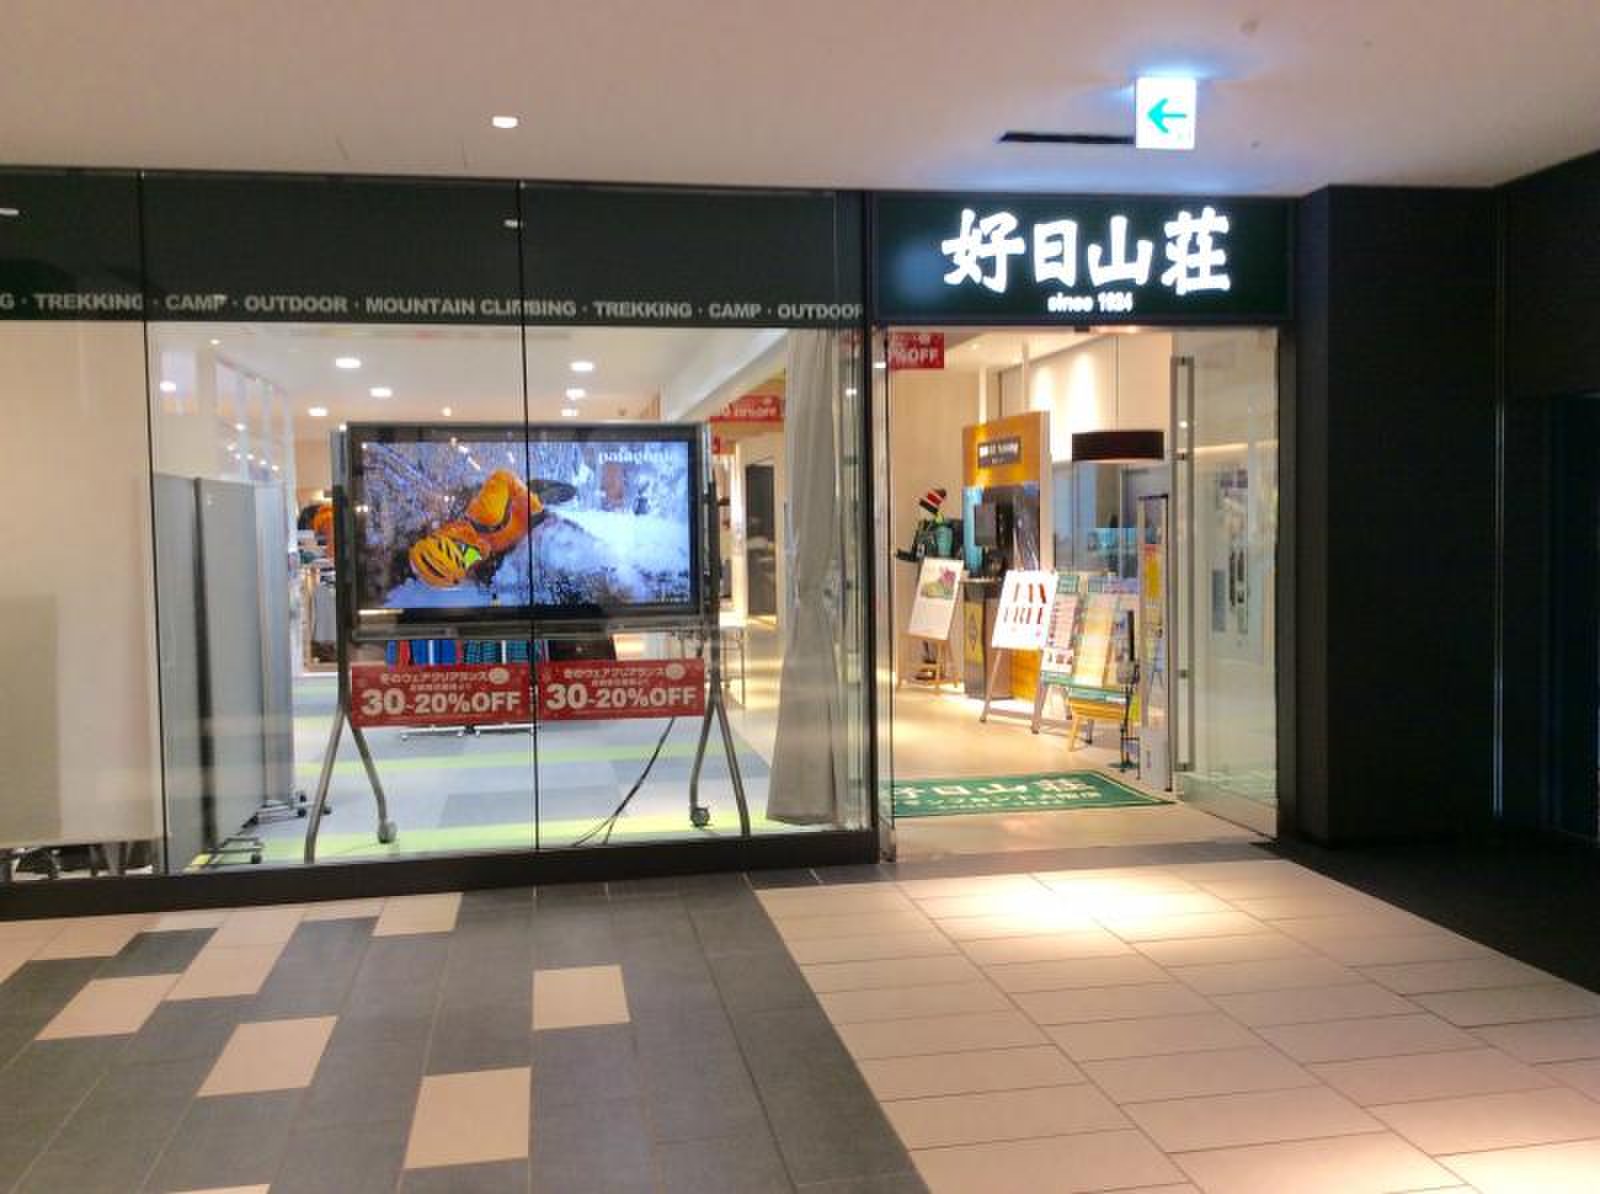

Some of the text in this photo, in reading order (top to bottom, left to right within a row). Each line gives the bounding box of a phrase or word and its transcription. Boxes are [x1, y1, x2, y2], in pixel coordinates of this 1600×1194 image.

[941, 206, 1231, 295] 好日山荘
[34, 293, 143, 311] TREKKING
[165, 294, 227, 311] CAMP
[244, 295, 348, 313] OUTDOOR
[366, 297, 476, 315] MOUNTAIN
[480, 298, 577, 317] CLIMBING
[593, 301, 692, 318] TREKKING
[709, 302, 762, 319] CAMP
